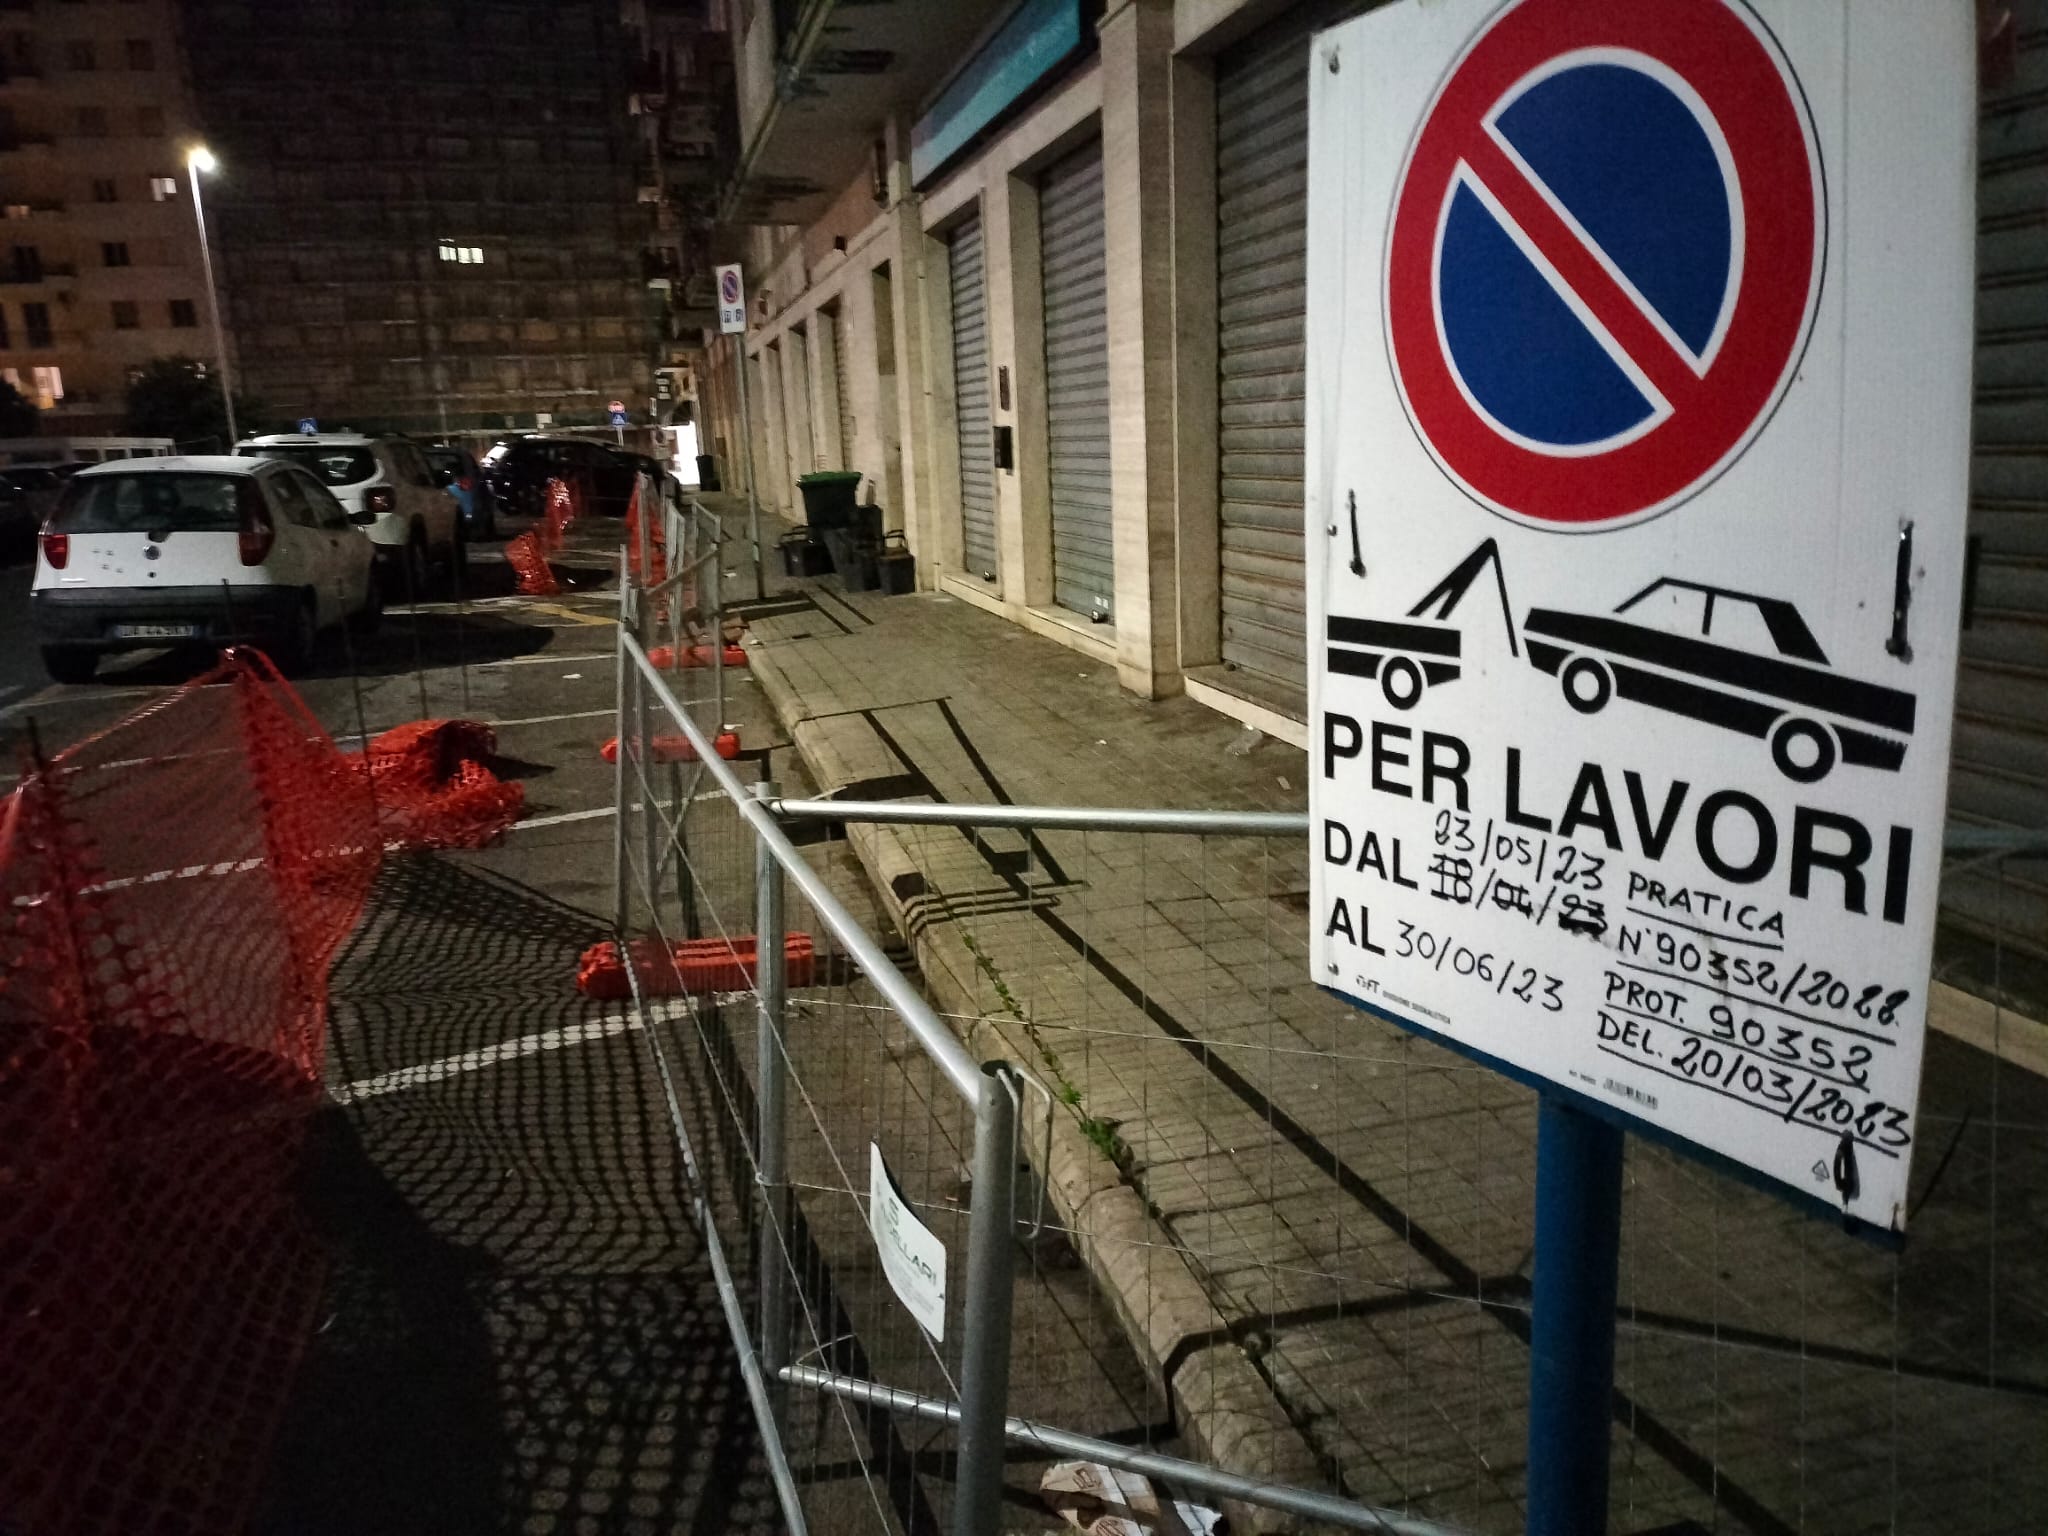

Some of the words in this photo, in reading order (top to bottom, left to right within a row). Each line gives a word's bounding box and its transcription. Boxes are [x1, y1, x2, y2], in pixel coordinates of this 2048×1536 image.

[1324, 711, 1471, 813] PER
[1505, 746, 1913, 925] LAVORI
[1324, 818, 1418, 890] DAL
[1326, 896, 1386, 957] AL
[1627, 870, 1785, 939] PRATICA
[1396, 919, 1563, 1012] 30/06/23
[1709, 1004, 1872, 1093] 90352
